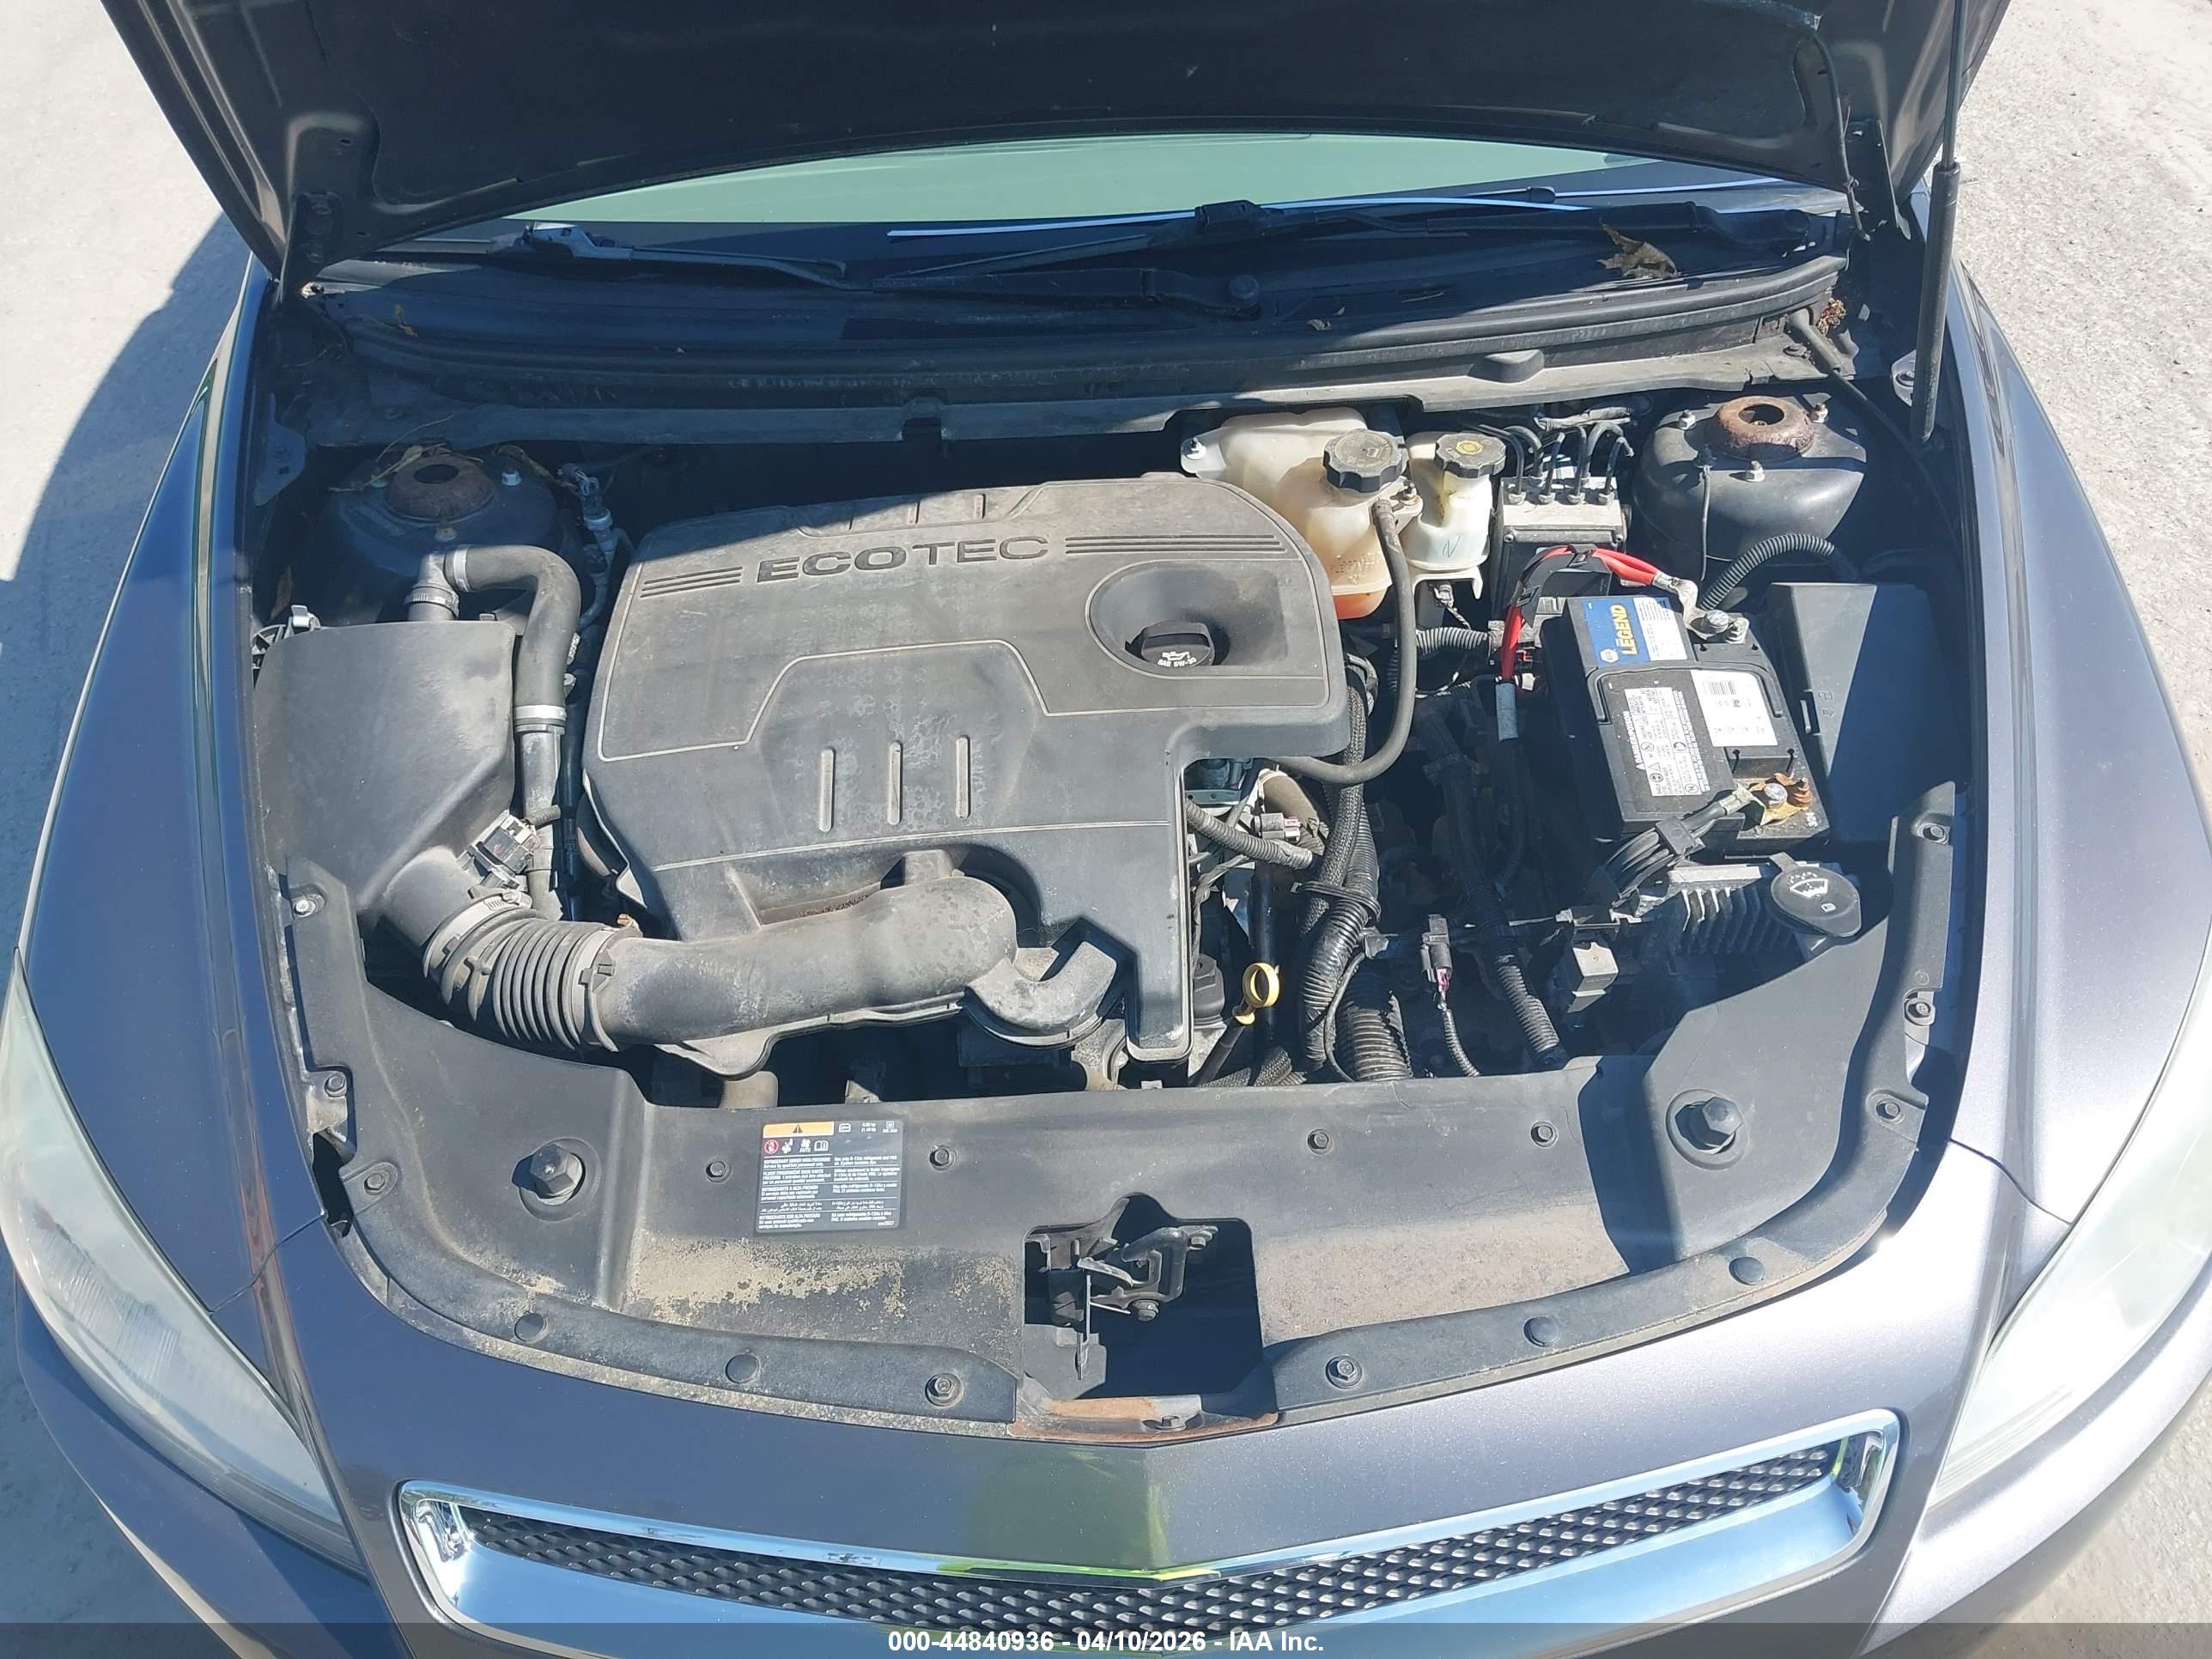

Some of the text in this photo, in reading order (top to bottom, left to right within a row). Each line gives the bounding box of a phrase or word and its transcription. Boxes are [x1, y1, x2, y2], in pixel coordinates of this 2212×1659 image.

[757, 536, 1049, 583] ECOTEC
[1611, 605, 1638, 655] LEGEND
[1157, 659, 1171, 667] SAE
